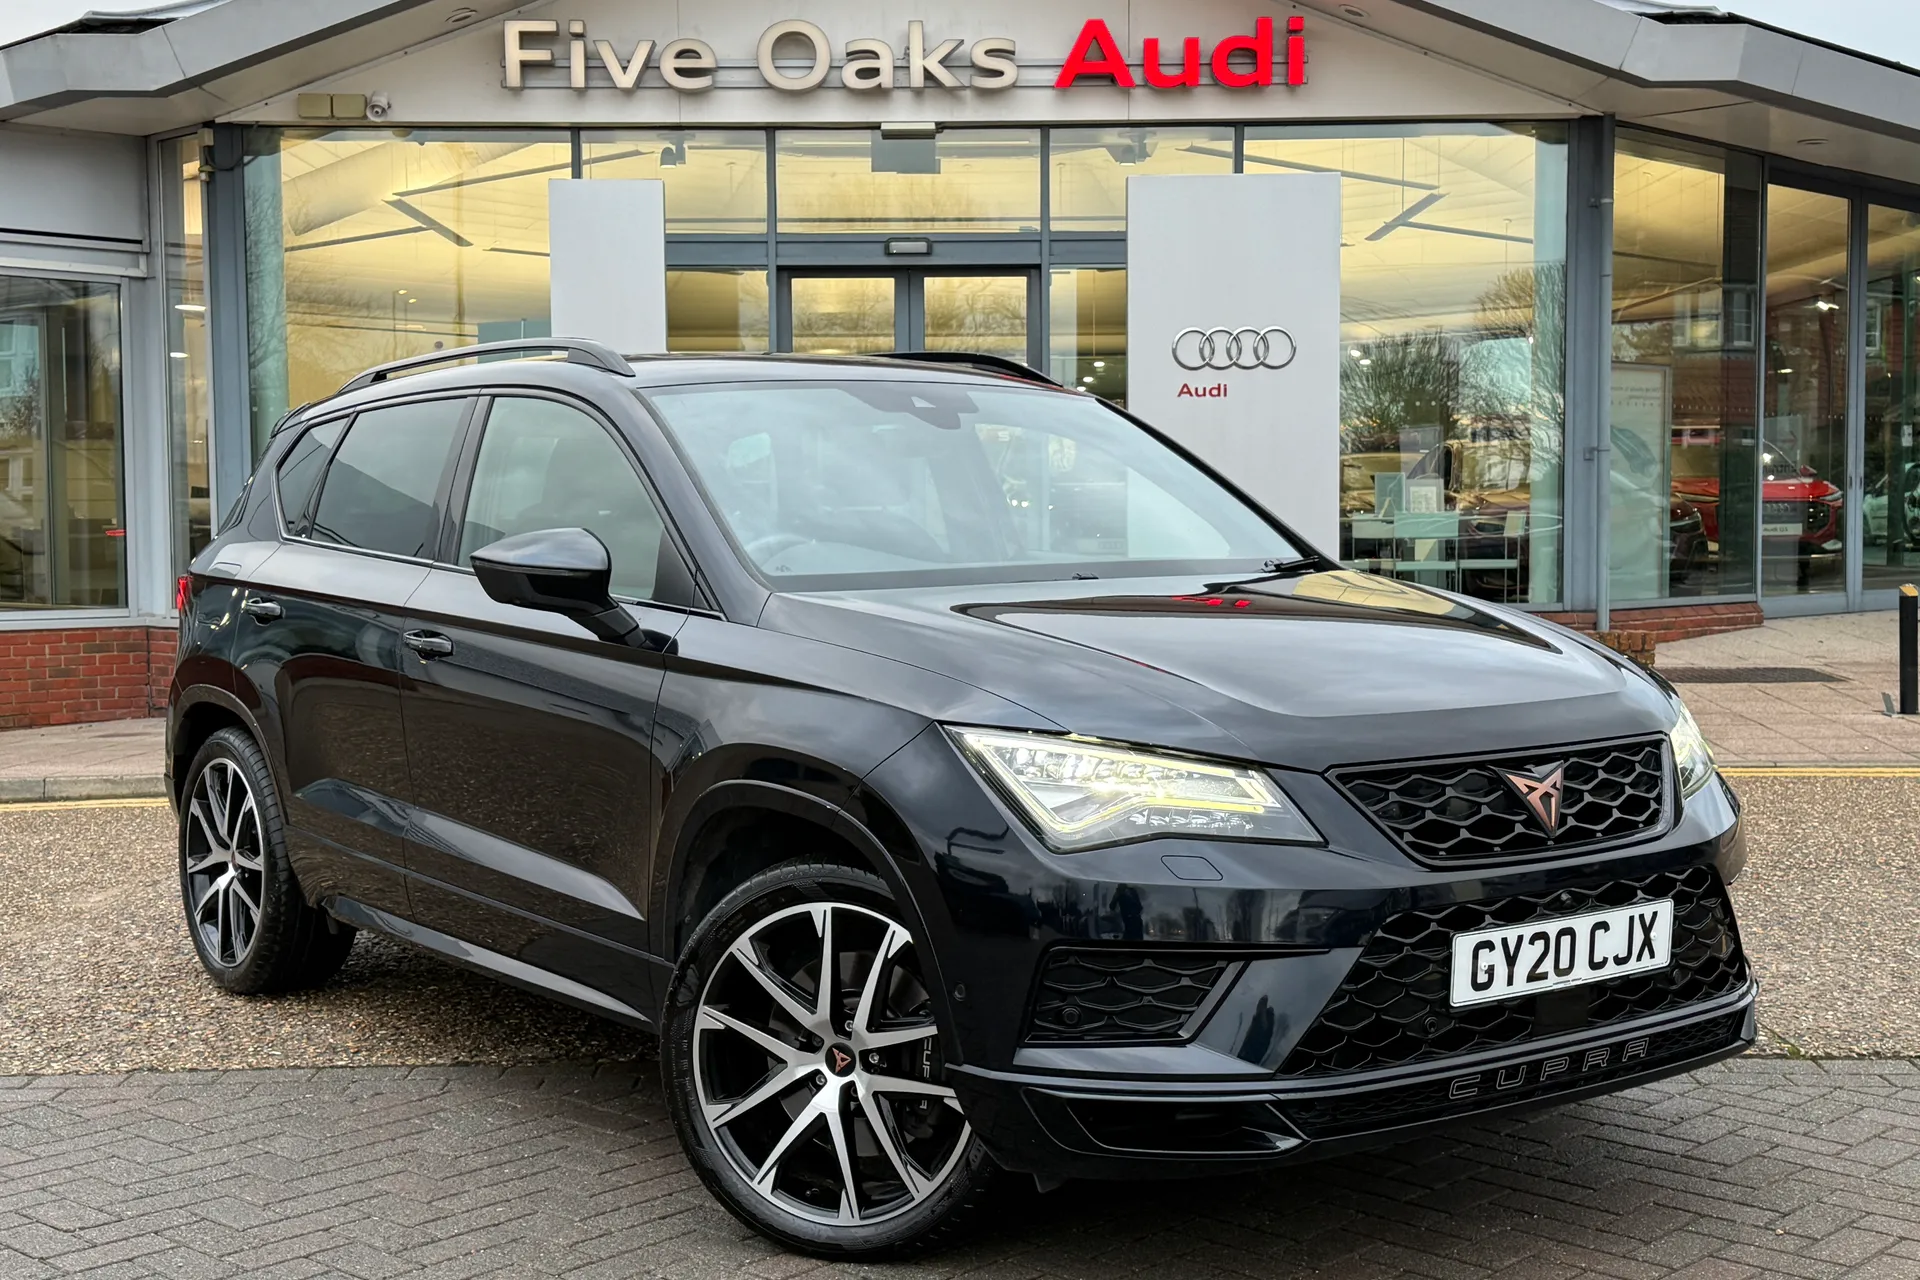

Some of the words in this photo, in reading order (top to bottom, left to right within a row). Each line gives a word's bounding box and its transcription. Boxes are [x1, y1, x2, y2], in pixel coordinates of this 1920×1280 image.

[503, 19, 717, 92] Five
[756, 19, 1018, 92] Oaks
[1054, 16, 1305, 89] Audi
[1177, 383, 1227, 397] Audi
[1470, 926, 1577, 992] GY20
[1588, 911, 1658, 971] CJX
[1449, 1037, 1650, 1099] CUPRA
